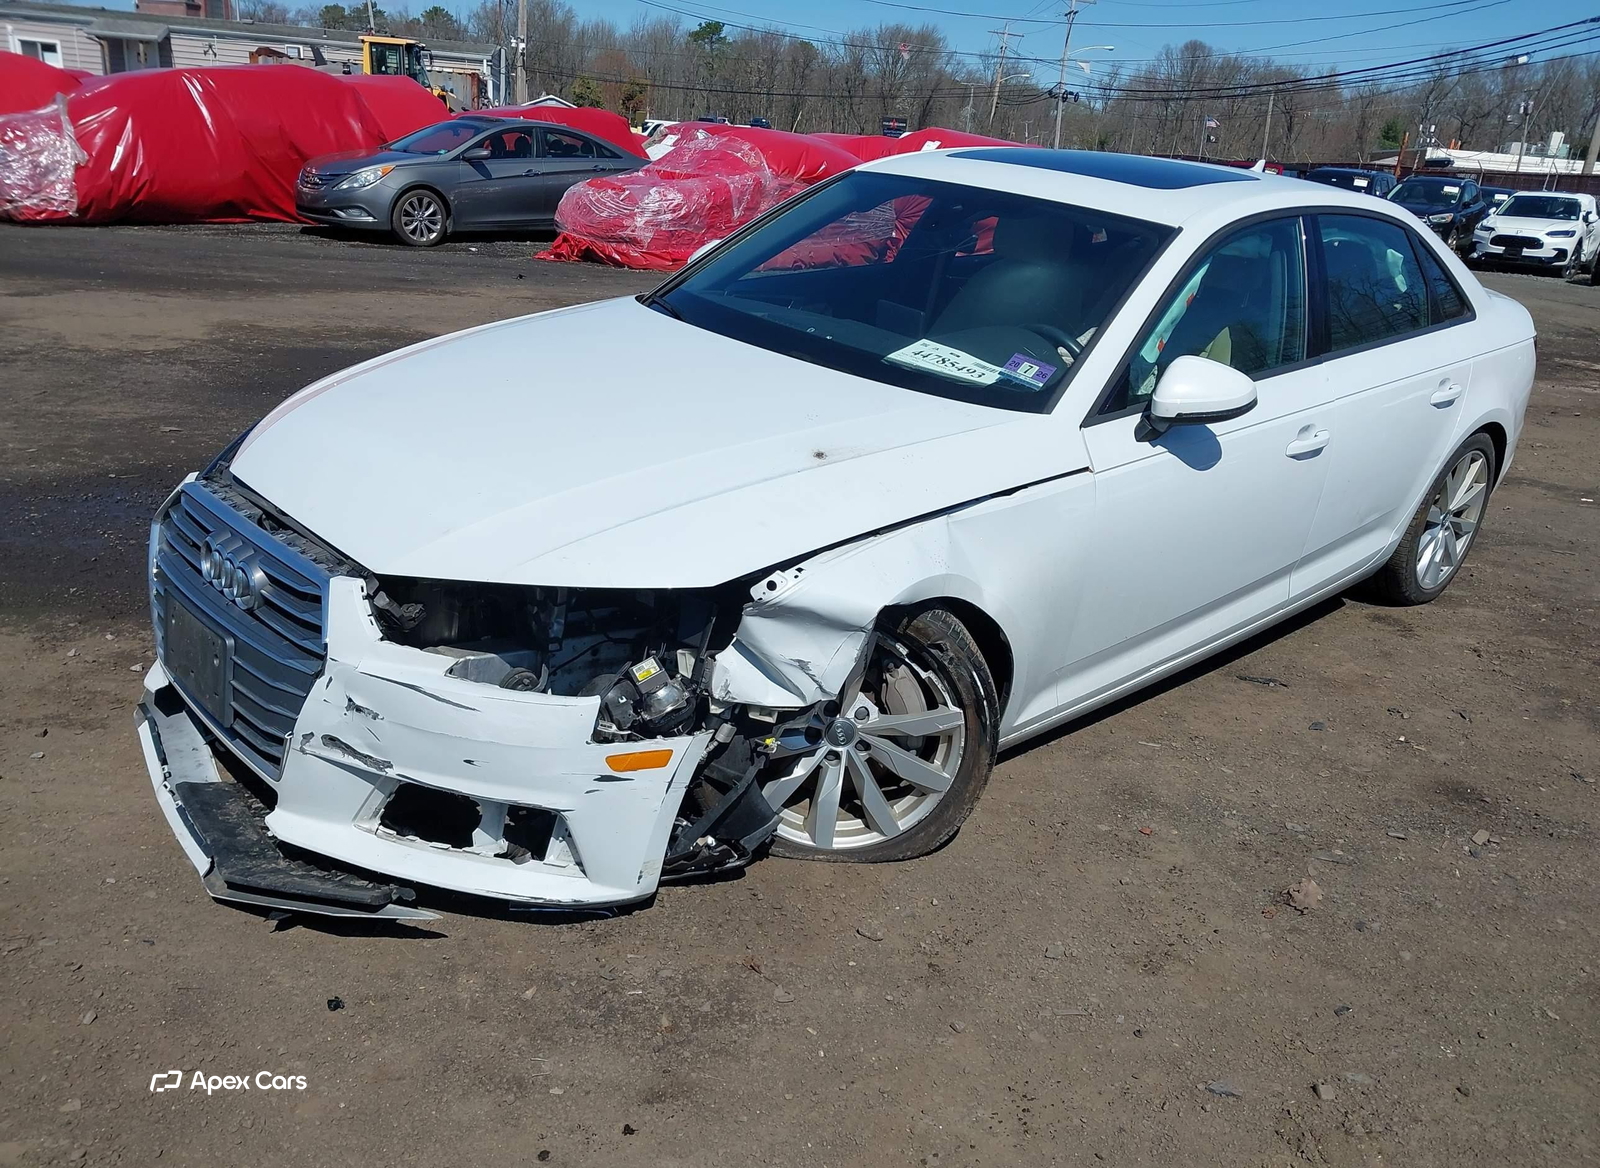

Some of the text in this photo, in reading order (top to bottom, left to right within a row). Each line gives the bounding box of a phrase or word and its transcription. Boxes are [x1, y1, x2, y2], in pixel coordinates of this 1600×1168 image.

[911, 349, 986, 379] 44785493
[1008, 360, 1020, 368] 20
[1023, 364, 1034, 374] 7
[1036, 370, 1048, 379] 26
